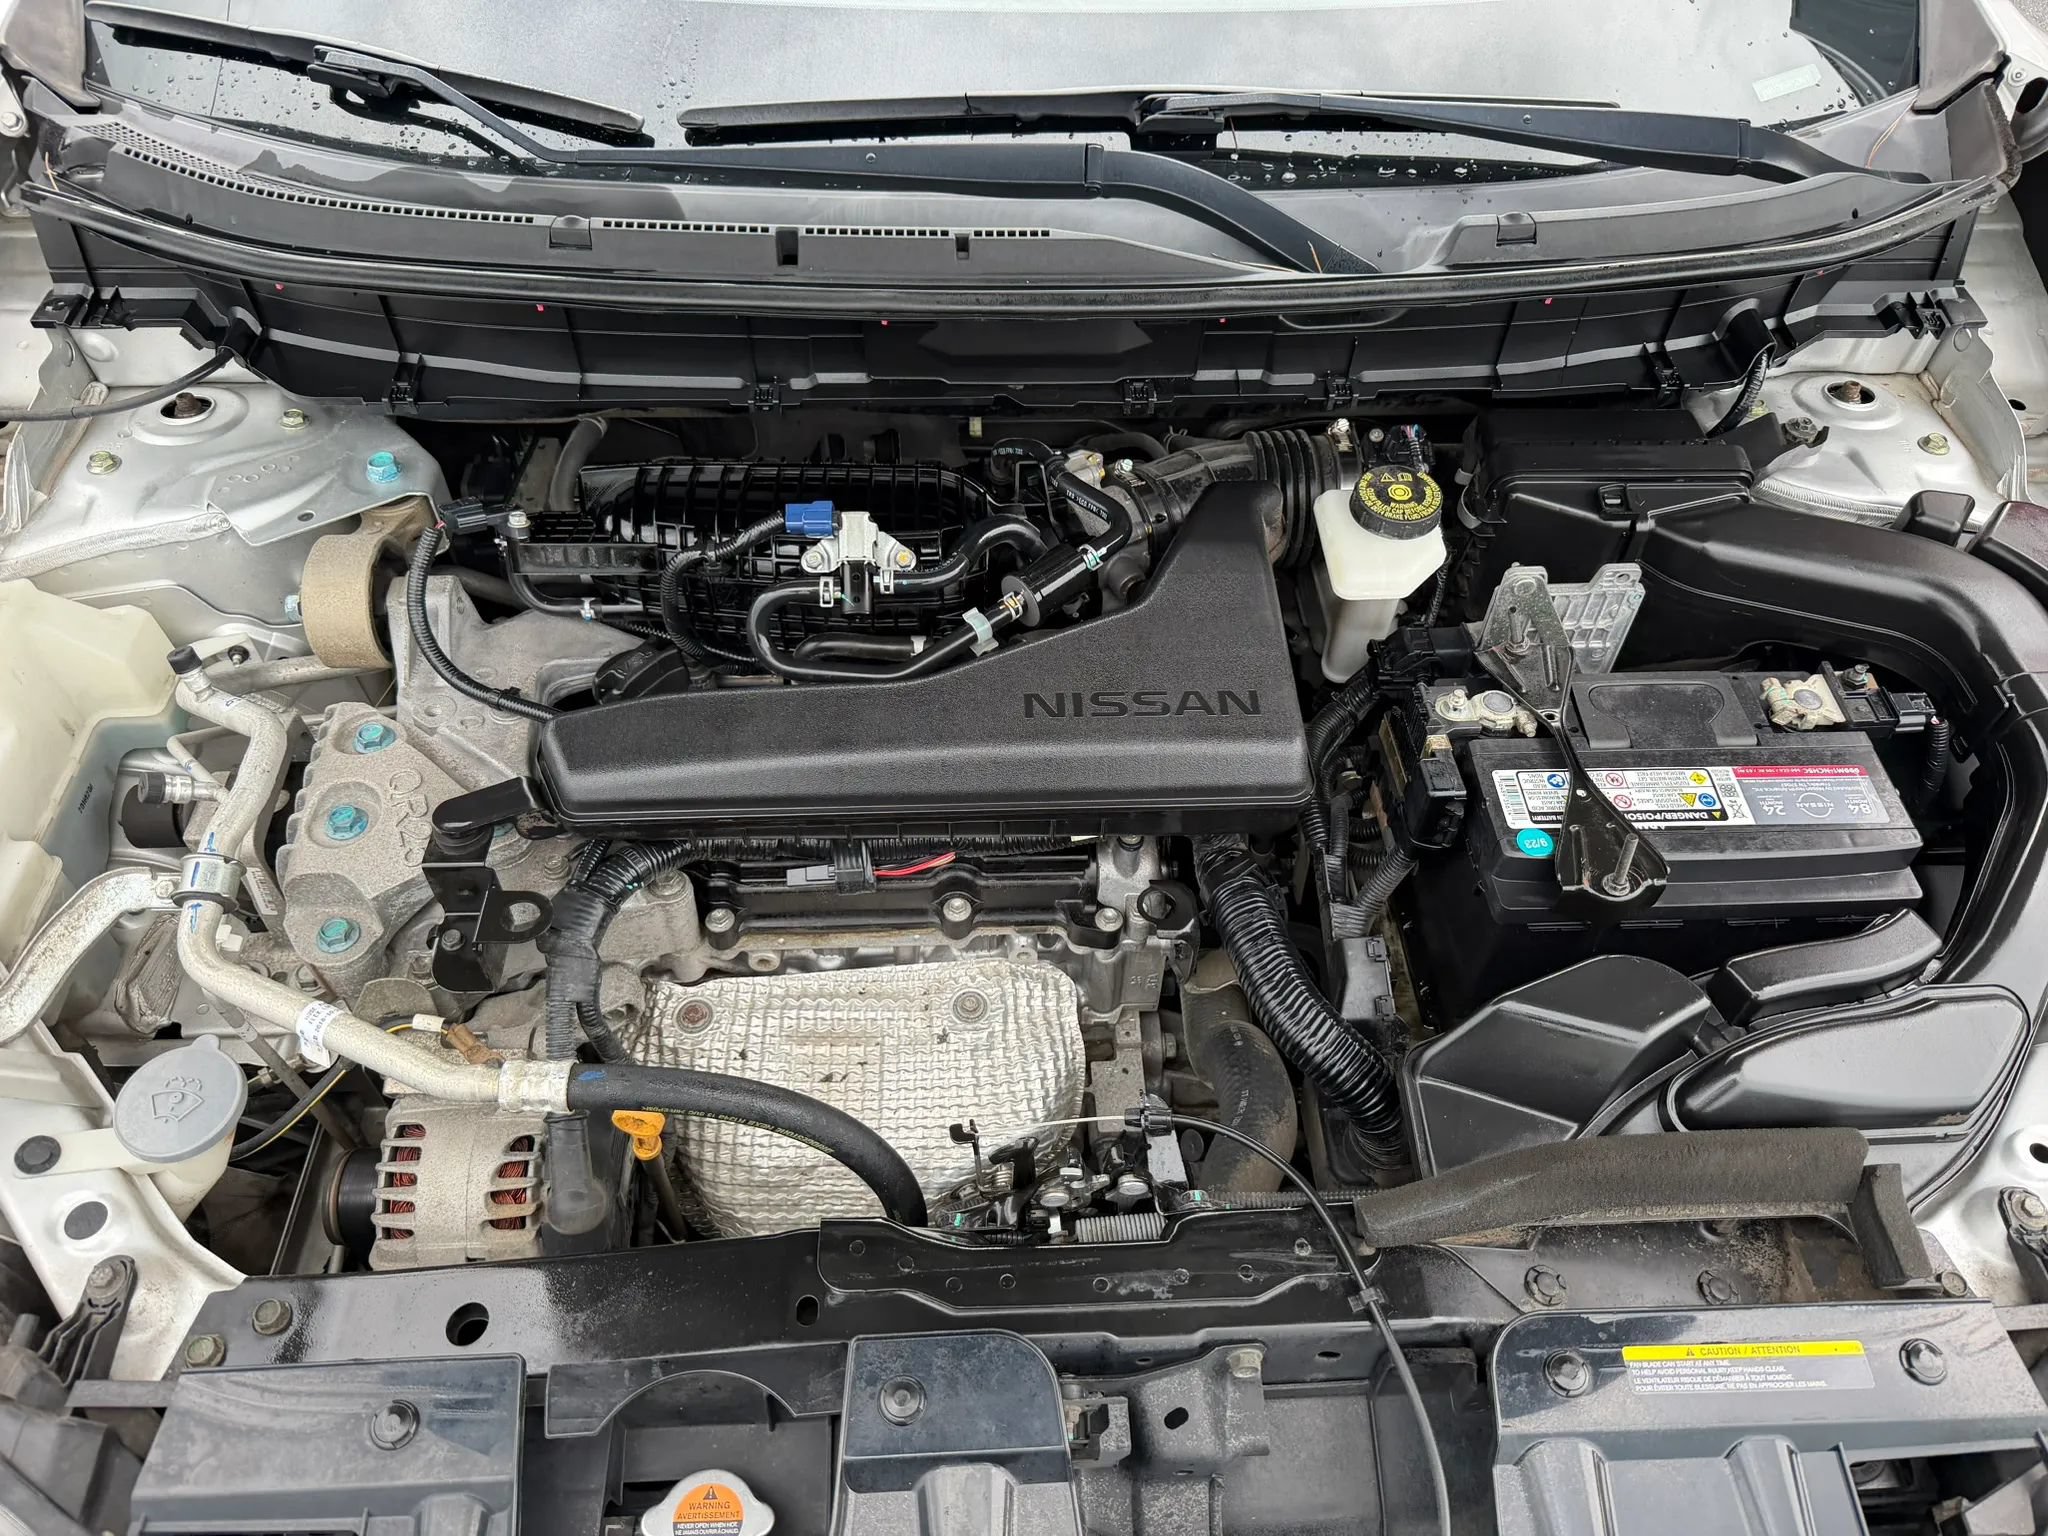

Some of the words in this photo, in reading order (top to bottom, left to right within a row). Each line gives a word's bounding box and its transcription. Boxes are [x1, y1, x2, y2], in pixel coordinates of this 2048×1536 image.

[1023, 690, 1262, 718] NISSAN
[1763, 805, 1786, 815] 24
[1848, 804, 1871, 815] 84
[1524, 838, 1548, 848] 9/23
[1700, 1346, 1741, 1356] CAUTION
[1751, 1346, 1800, 1354] ATTENTION
[689, 1501, 730, 1510] WARNING
[677, 1511, 740, 1520] AVERTISSEMENT
